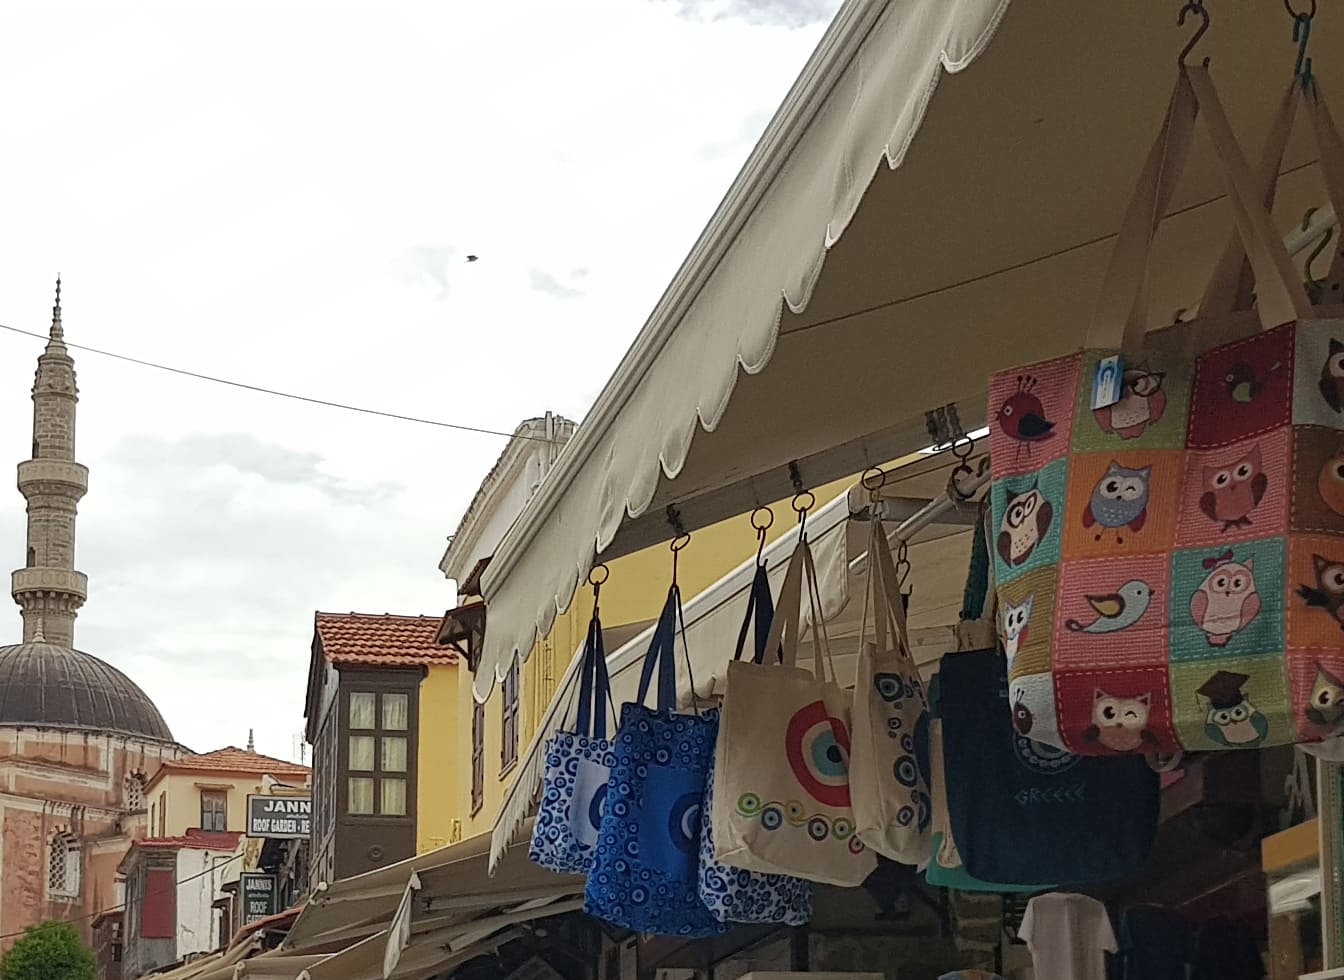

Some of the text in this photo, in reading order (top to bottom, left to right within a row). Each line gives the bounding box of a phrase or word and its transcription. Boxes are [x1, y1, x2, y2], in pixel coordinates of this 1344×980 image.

[253, 818, 270, 832] ROOF
[271, 819, 297, 833] GARDEN
[246, 879, 272, 891] JANNIS
[250, 901, 268, 913] ROOF
